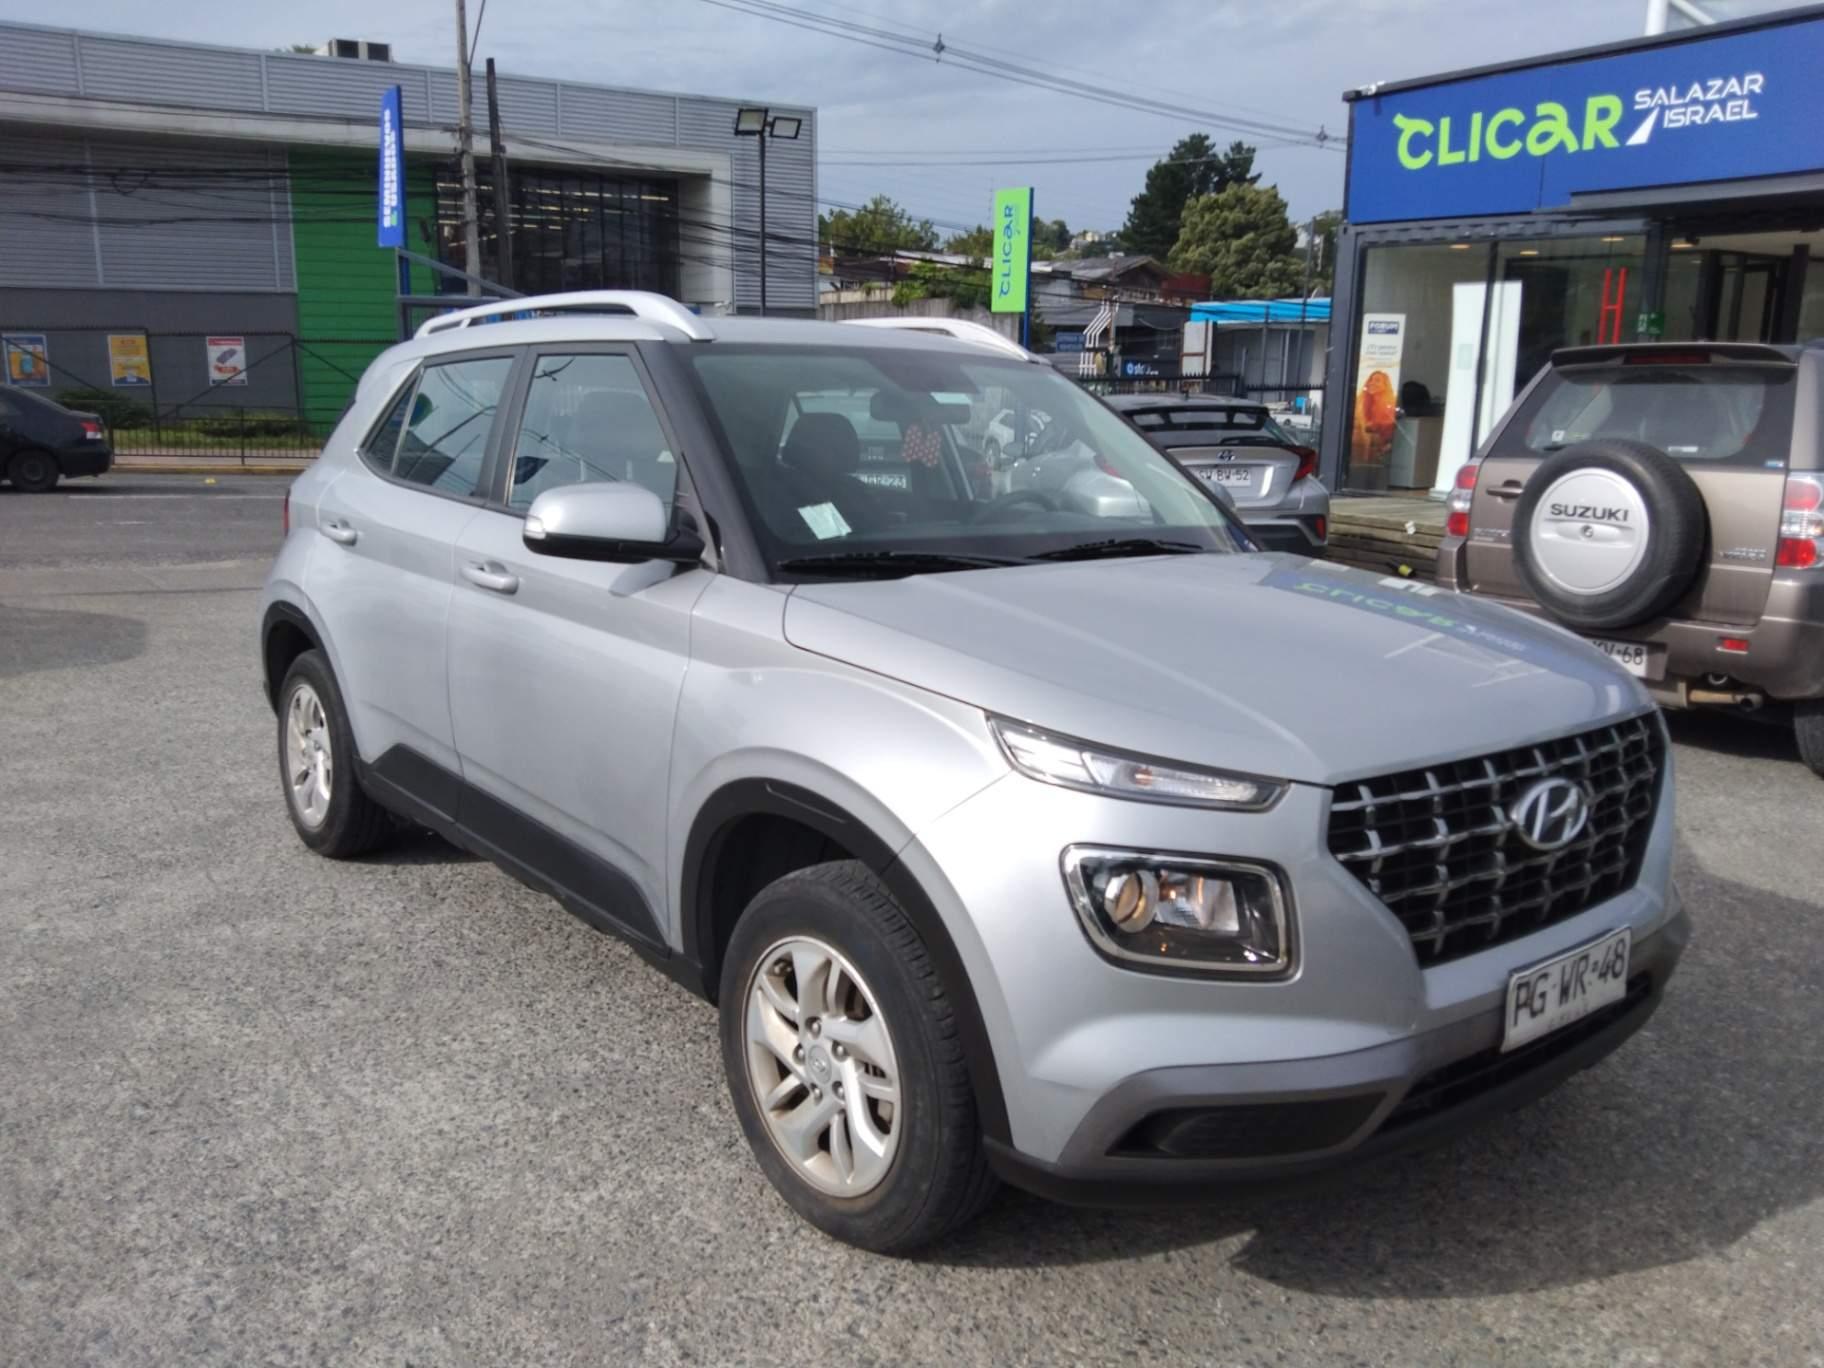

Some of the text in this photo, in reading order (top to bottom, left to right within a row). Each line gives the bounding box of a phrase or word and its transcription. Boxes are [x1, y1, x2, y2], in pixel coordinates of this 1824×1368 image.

[1633, 73, 1765, 110] SALAZAR
[1662, 99, 1759, 128] ISRAEL
[1550, 503, 1629, 522] SUZUKI
